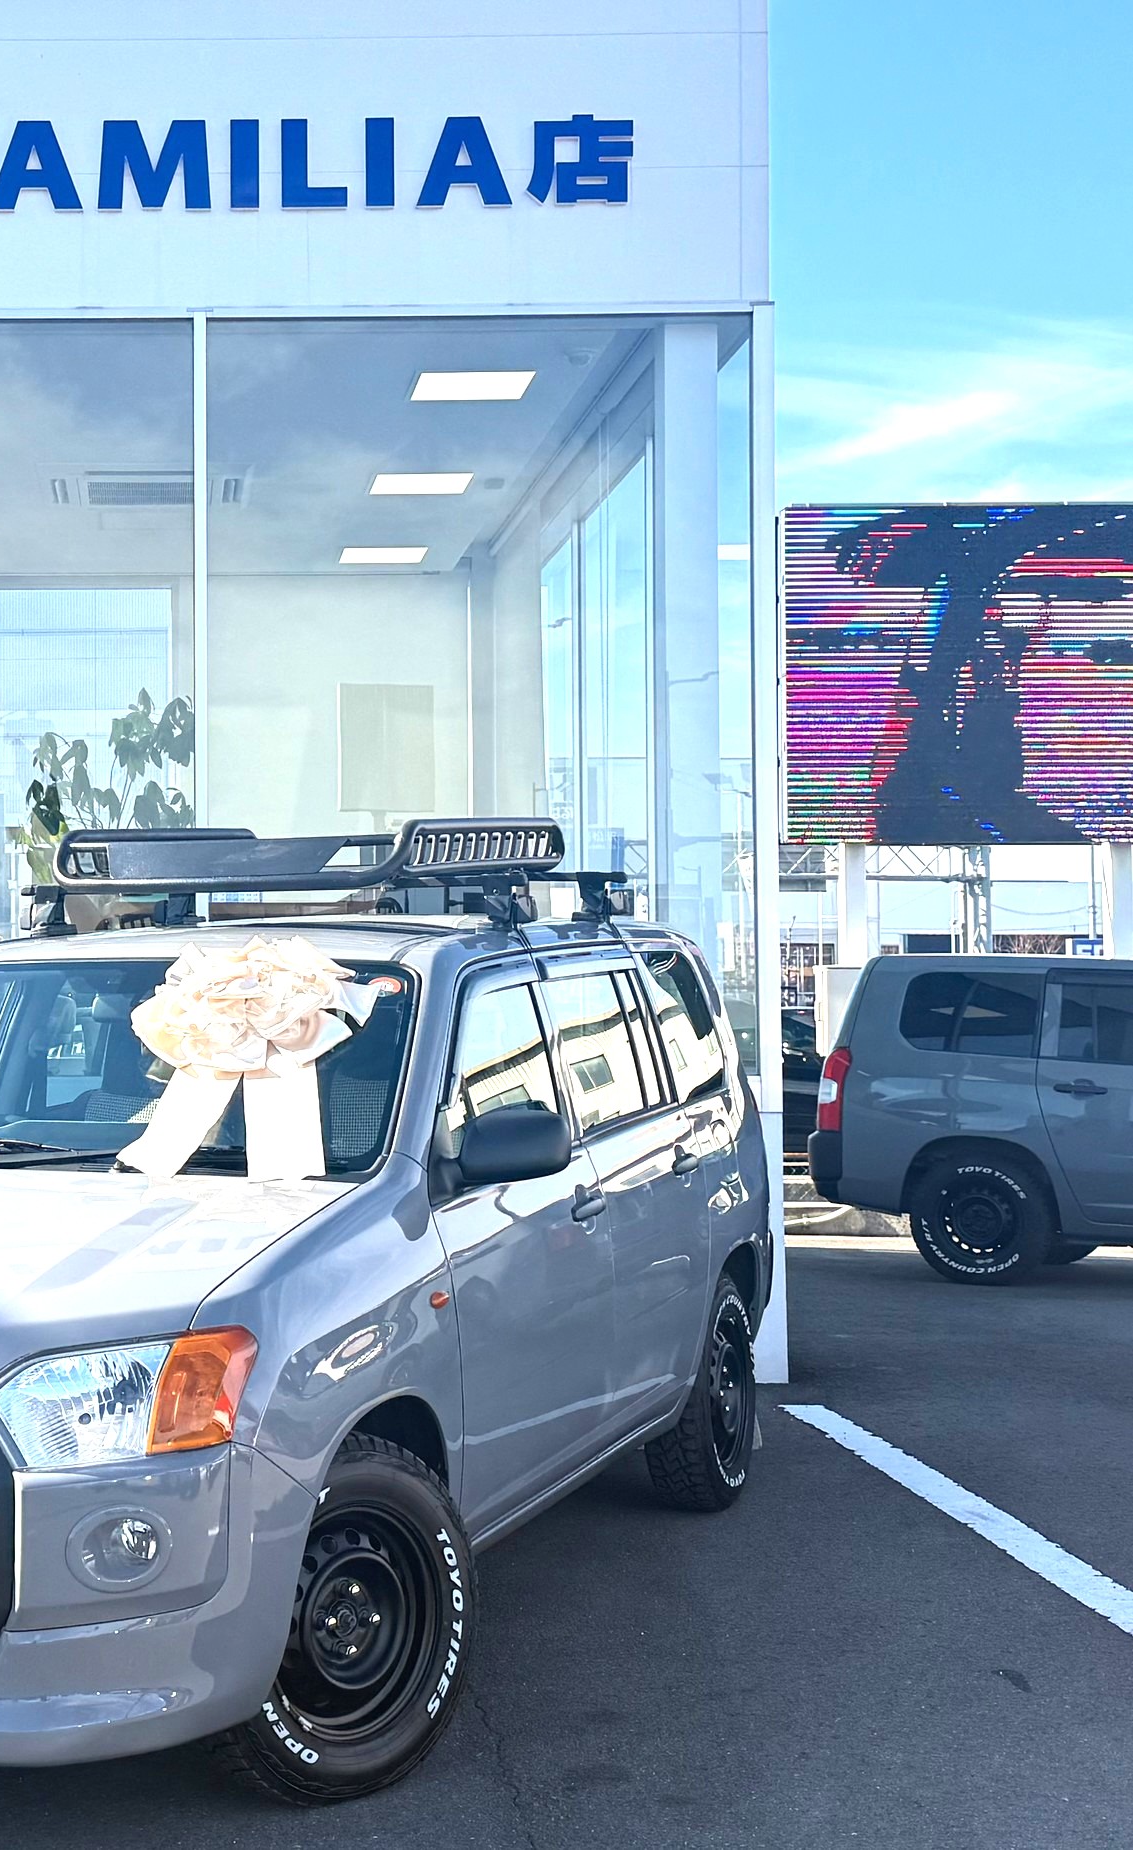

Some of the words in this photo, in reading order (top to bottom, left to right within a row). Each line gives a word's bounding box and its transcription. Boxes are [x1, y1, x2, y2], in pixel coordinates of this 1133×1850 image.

[957, 1166, 993, 1175] TOYO
[994, 1171, 1028, 1200] TIRES
[929, 1243, 985, 1274] COUNTRY
[987, 1253, 1020, 1274] OPEN
[436, 1528, 465, 1612] TOYO
[426, 1619, 463, 1719] TIRES
[262, 1699, 320, 1764] OPEN
